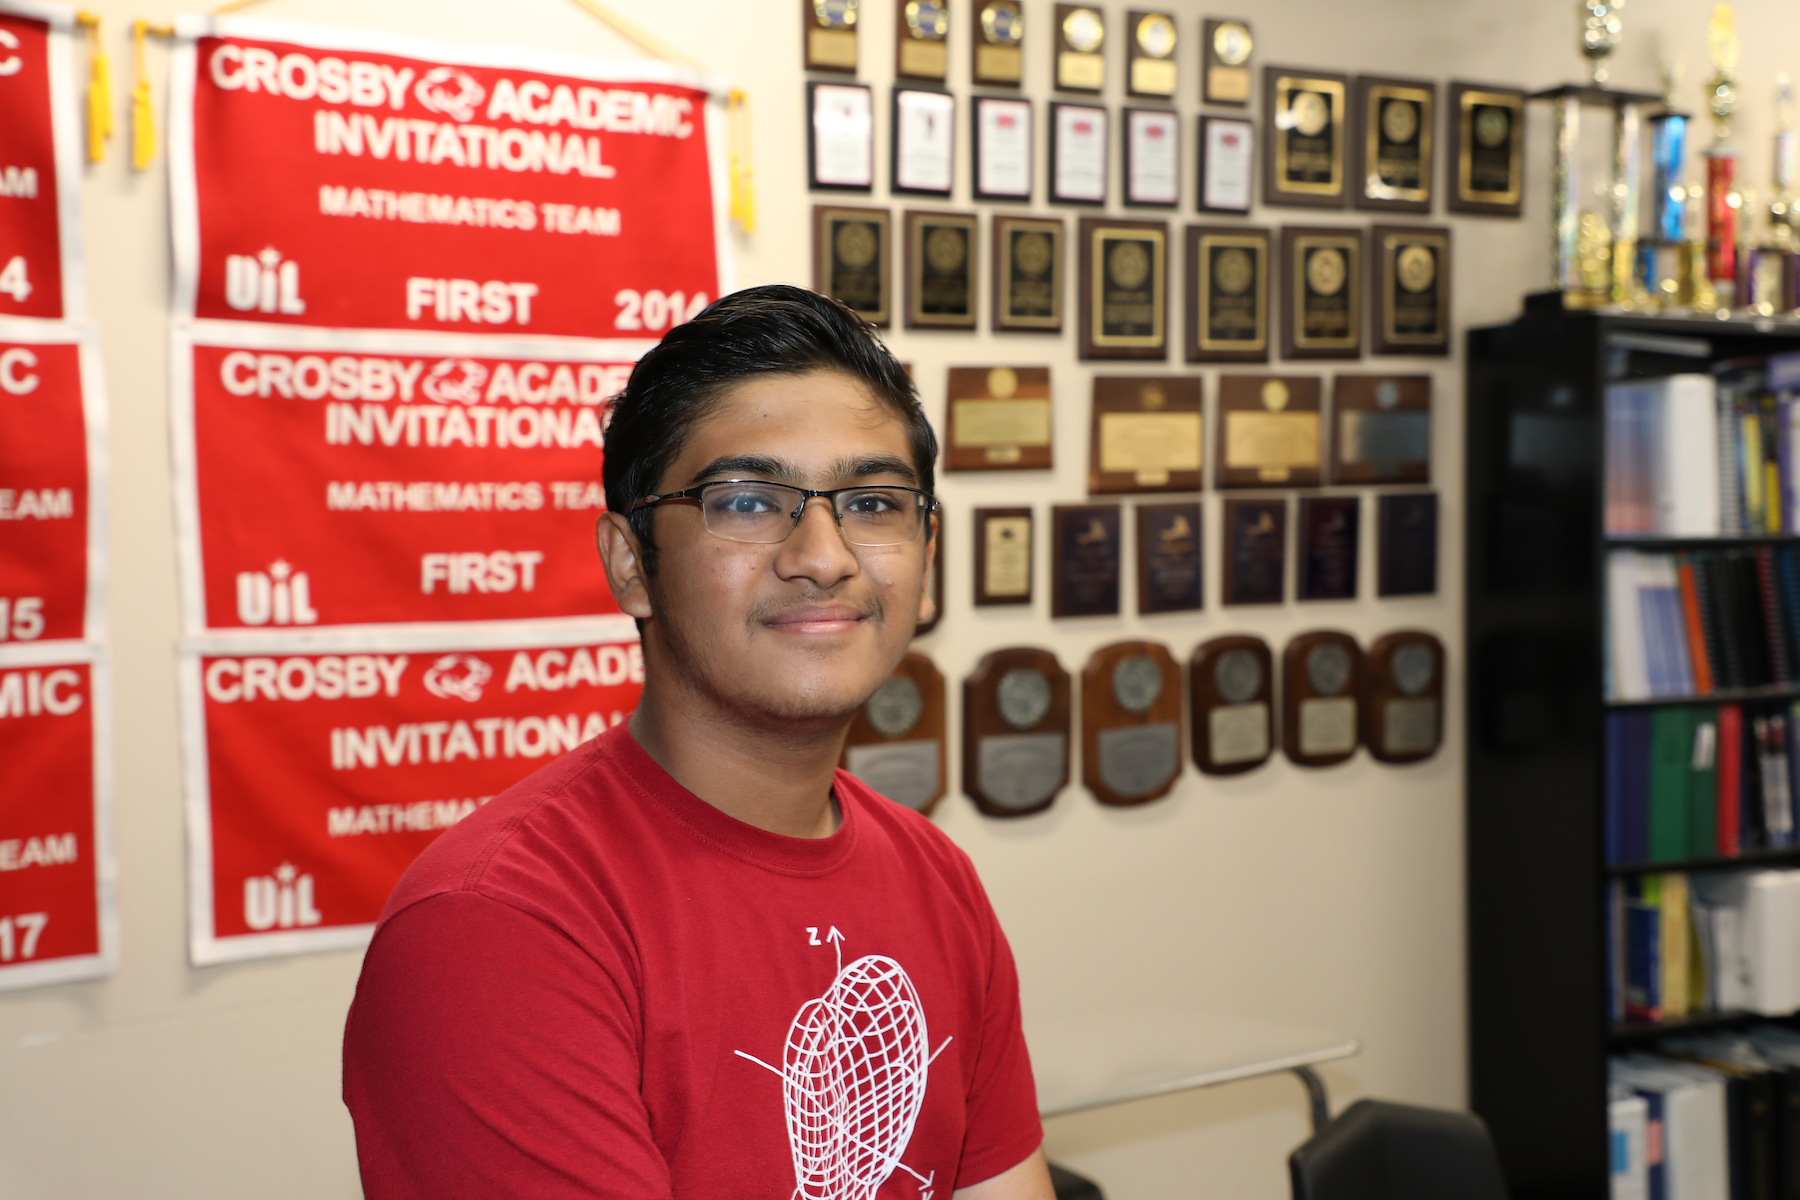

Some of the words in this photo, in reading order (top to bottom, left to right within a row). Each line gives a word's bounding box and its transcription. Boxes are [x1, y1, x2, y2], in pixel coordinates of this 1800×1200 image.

[210, 44, 415, 110] CROSBY
[486, 78, 693, 139] ACADEMIC
[314, 109, 615, 179] INVITATIONAL
[319, 185, 537, 231] MATHEMATICS
[541, 203, 621, 237] TEAM
[406, 277, 538, 325] FIRST
[220, 351, 424, 402] CROSBY
[327, 480, 543, 512] MATHEMATICS
[549, 480, 607, 511] TEA
[421, 551, 545, 595] FIRST
[205, 655, 409, 704] CROSBY
[328, 796, 496, 838] MATHEMA
